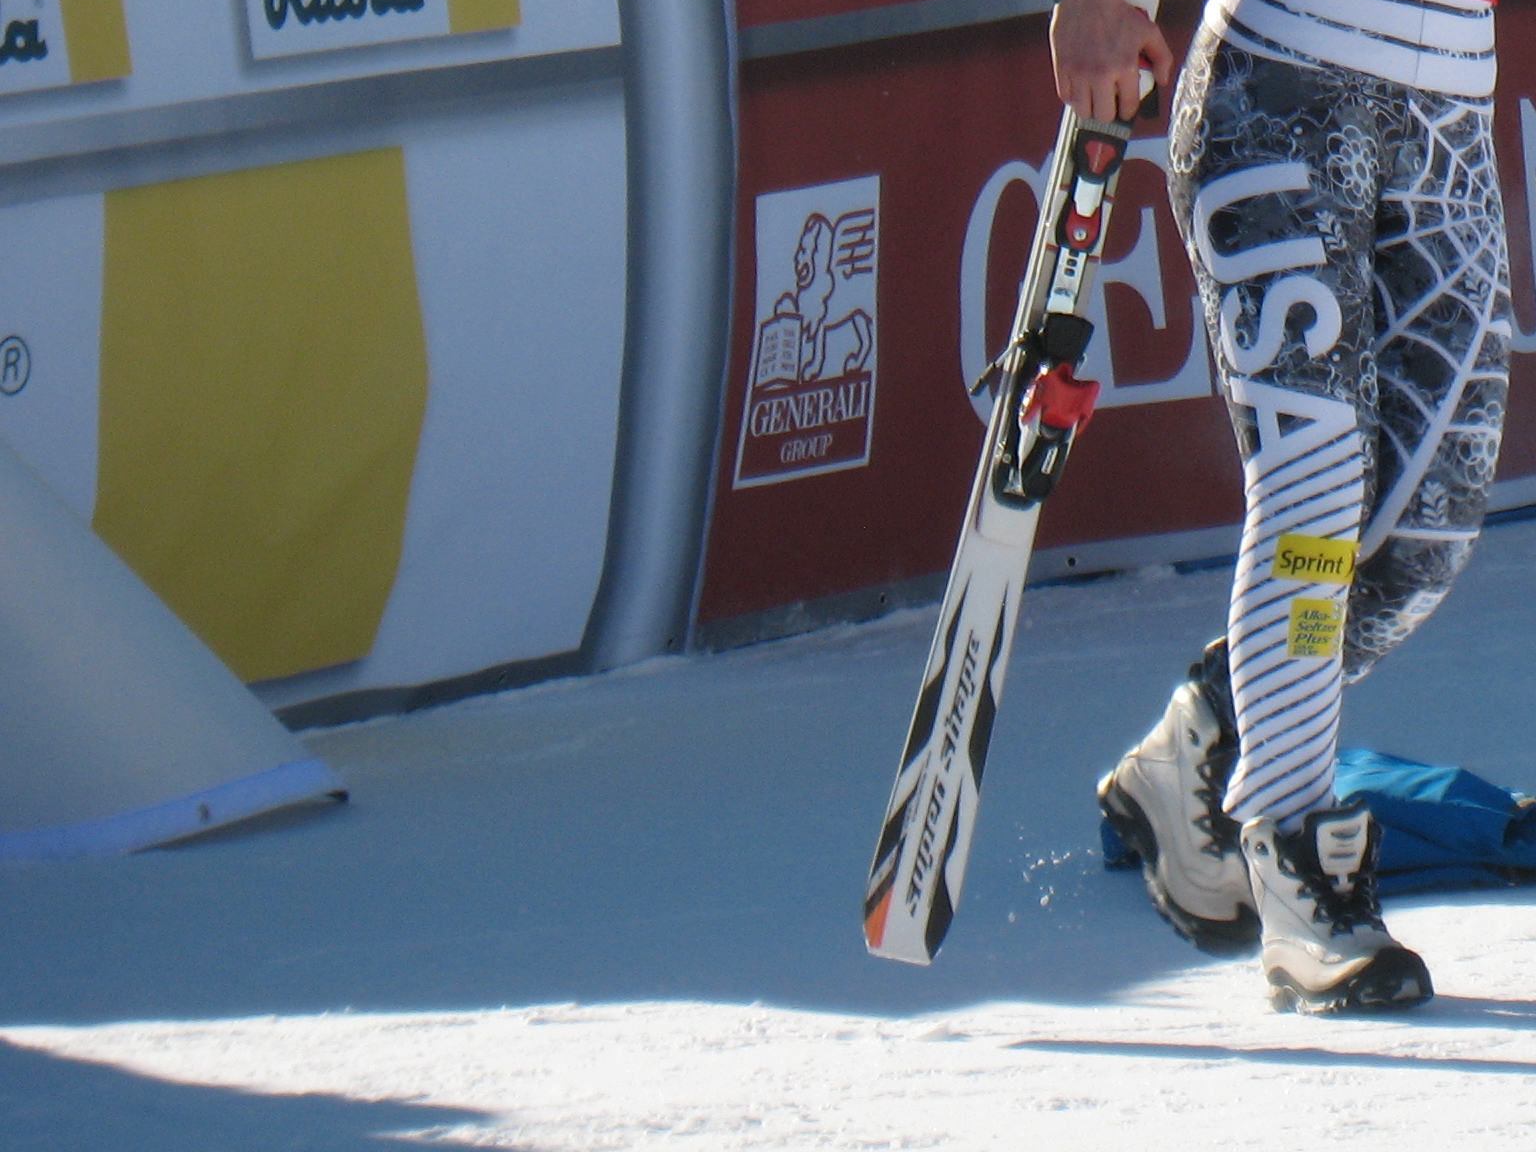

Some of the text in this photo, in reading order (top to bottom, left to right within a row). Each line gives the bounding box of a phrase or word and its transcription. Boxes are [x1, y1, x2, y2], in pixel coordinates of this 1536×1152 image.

[1193, 161, 1359, 480] USA
[751, 381, 869, 437] GENERALI
[780, 433, 833, 463] GROUP
[1279, 549, 1344, 575] Sprint
